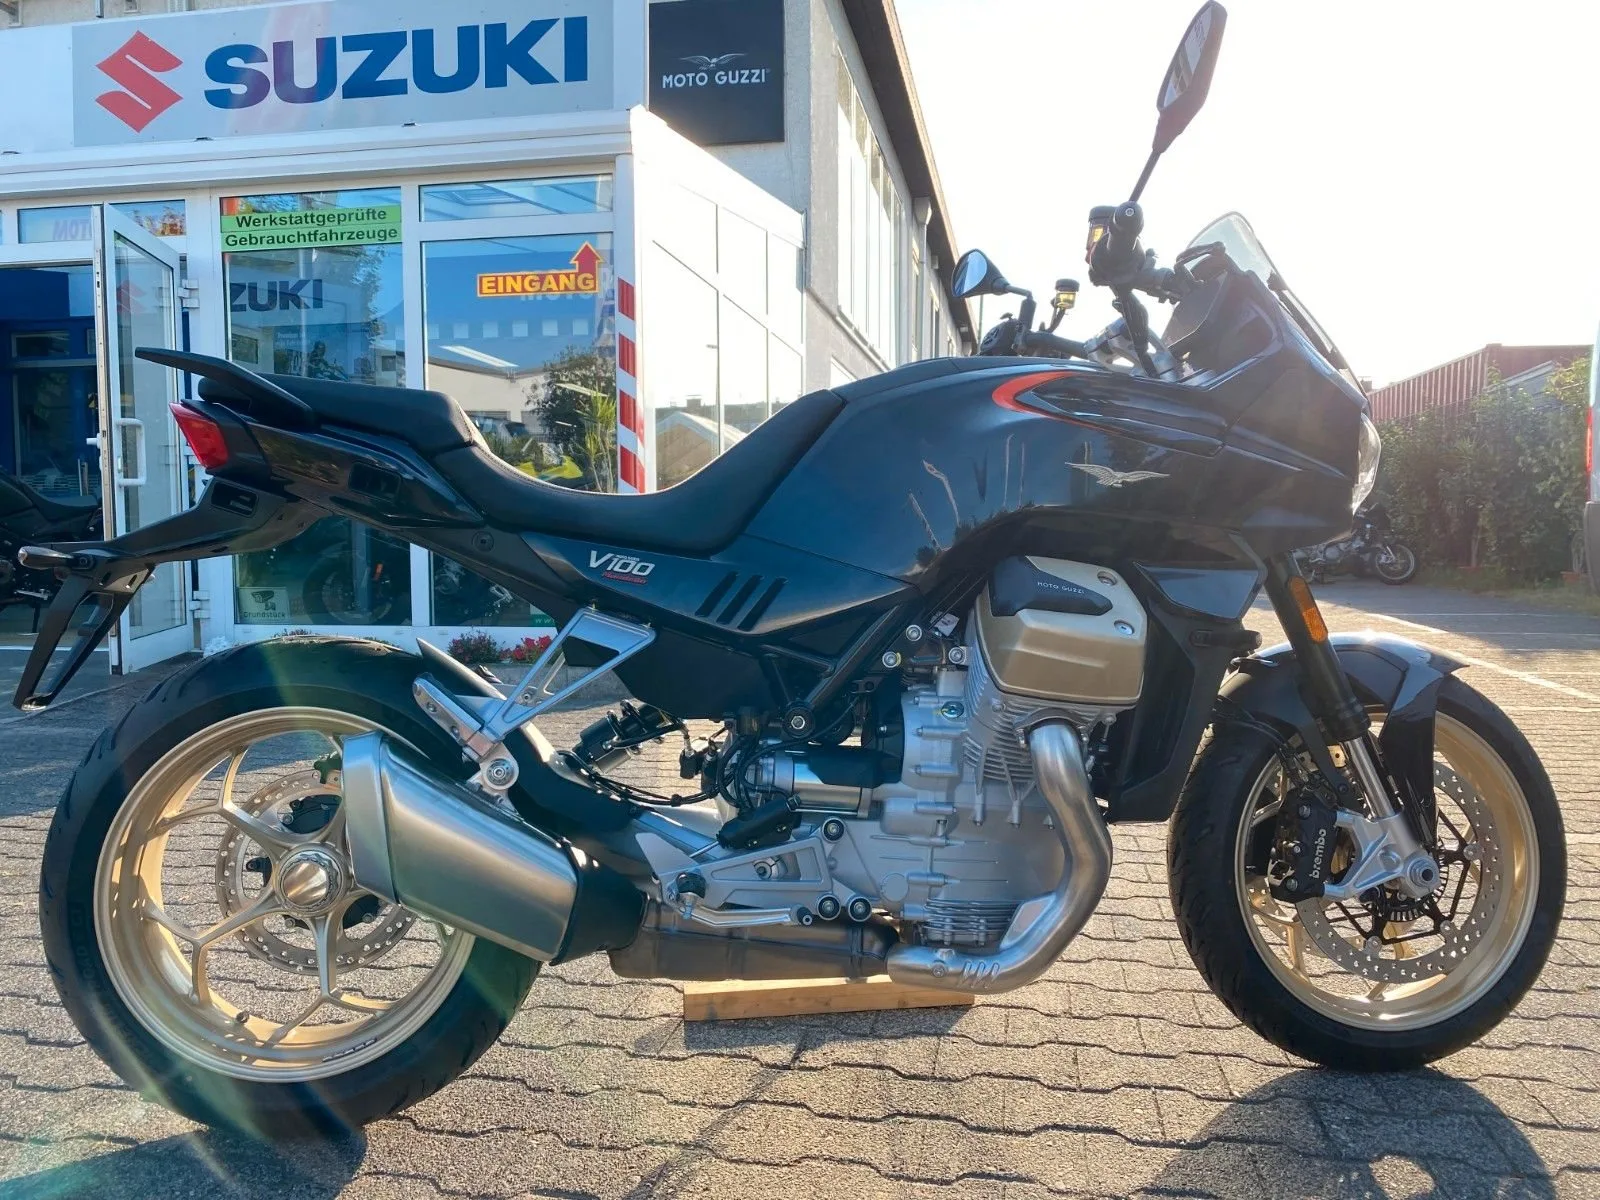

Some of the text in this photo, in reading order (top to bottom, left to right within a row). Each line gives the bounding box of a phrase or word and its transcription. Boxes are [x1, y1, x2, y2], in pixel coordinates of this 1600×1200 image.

[204, 16, 588, 109] SUZUKI
[662, 69, 766, 89] MOTO GUZZI
[236, 208, 387, 228] Werkstattgeprüfte
[225, 228, 398, 247] Gebrauchtfahrzeuge
[481, 272, 594, 294] EINGANG
[589, 550, 655, 576] V100
[1309, 828, 1327, 879] brembo
